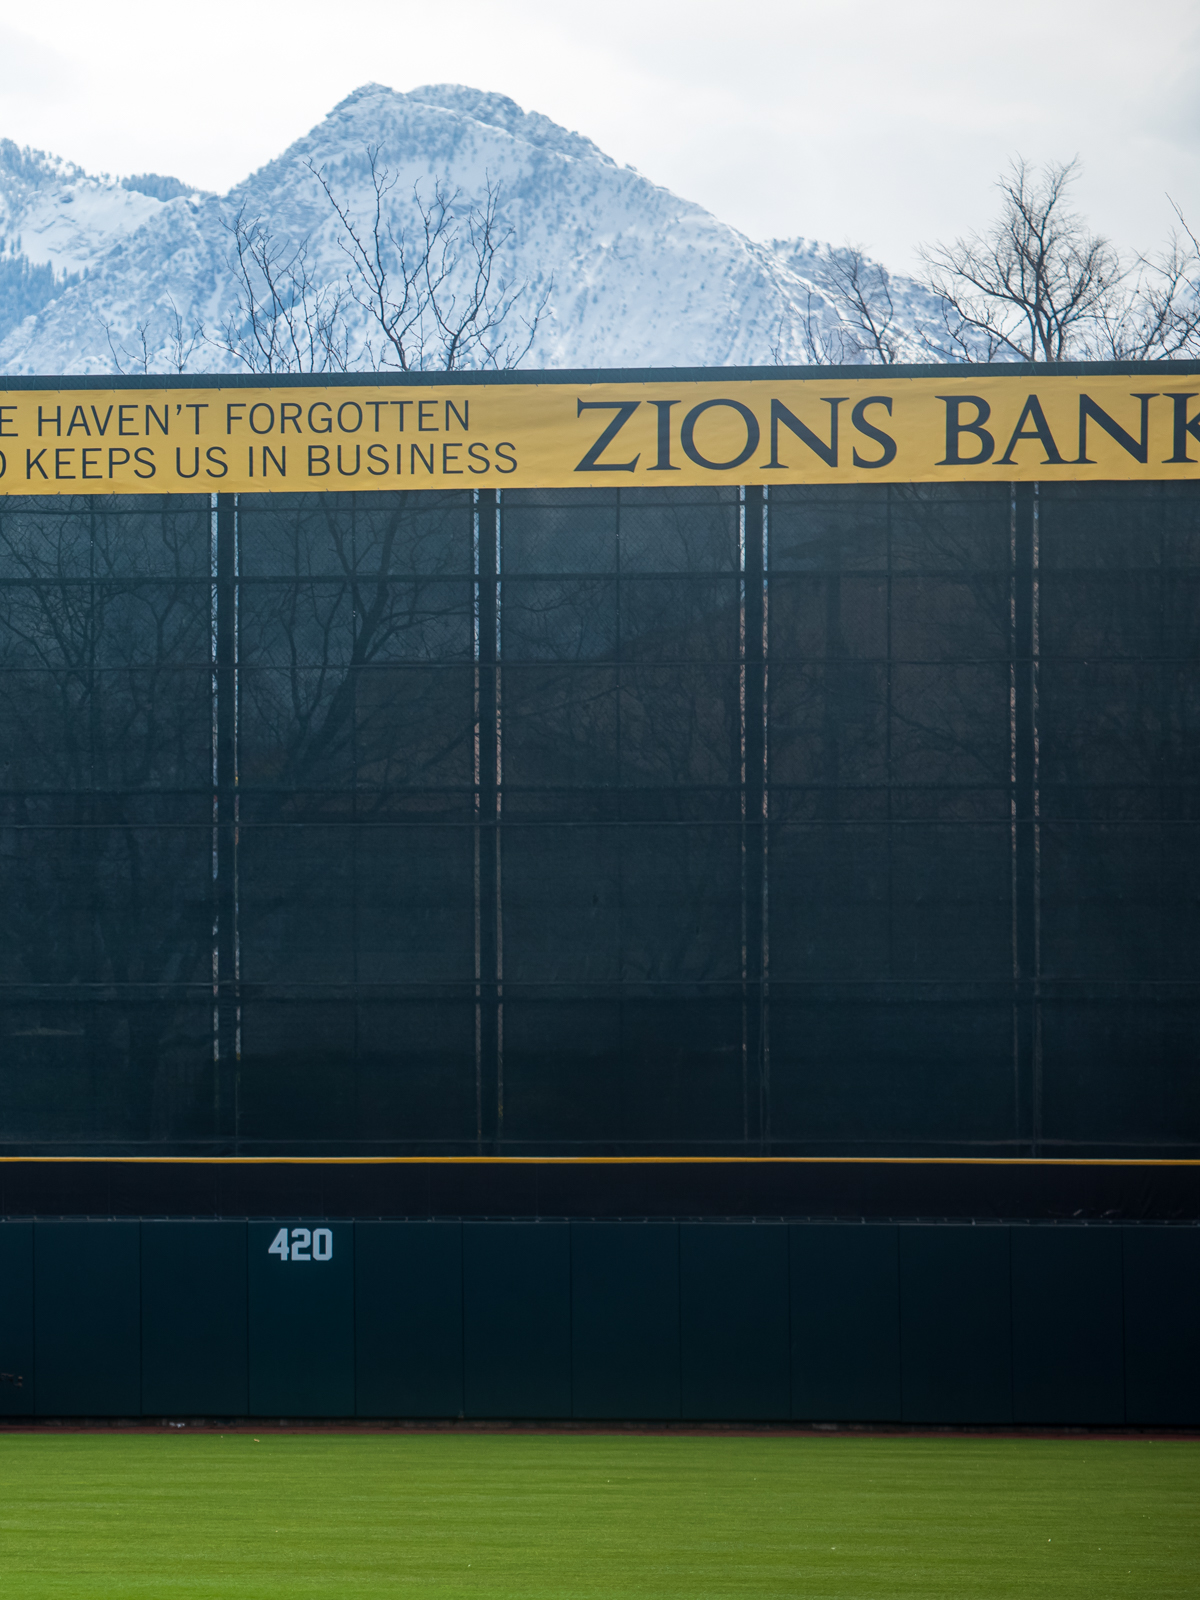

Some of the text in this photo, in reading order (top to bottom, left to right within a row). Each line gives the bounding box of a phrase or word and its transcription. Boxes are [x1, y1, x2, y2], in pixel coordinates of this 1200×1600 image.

[227, 400, 468, 434] FORGOTTEN
[574, 396, 896, 472] ZIONS
[27, 447, 155, 479] KEEPS
[177, 447, 227, 478] US
[249, 446, 285, 477] IN
[308, 443, 517, 476] BUSINESS
[268, 1228, 332, 1261] 420
